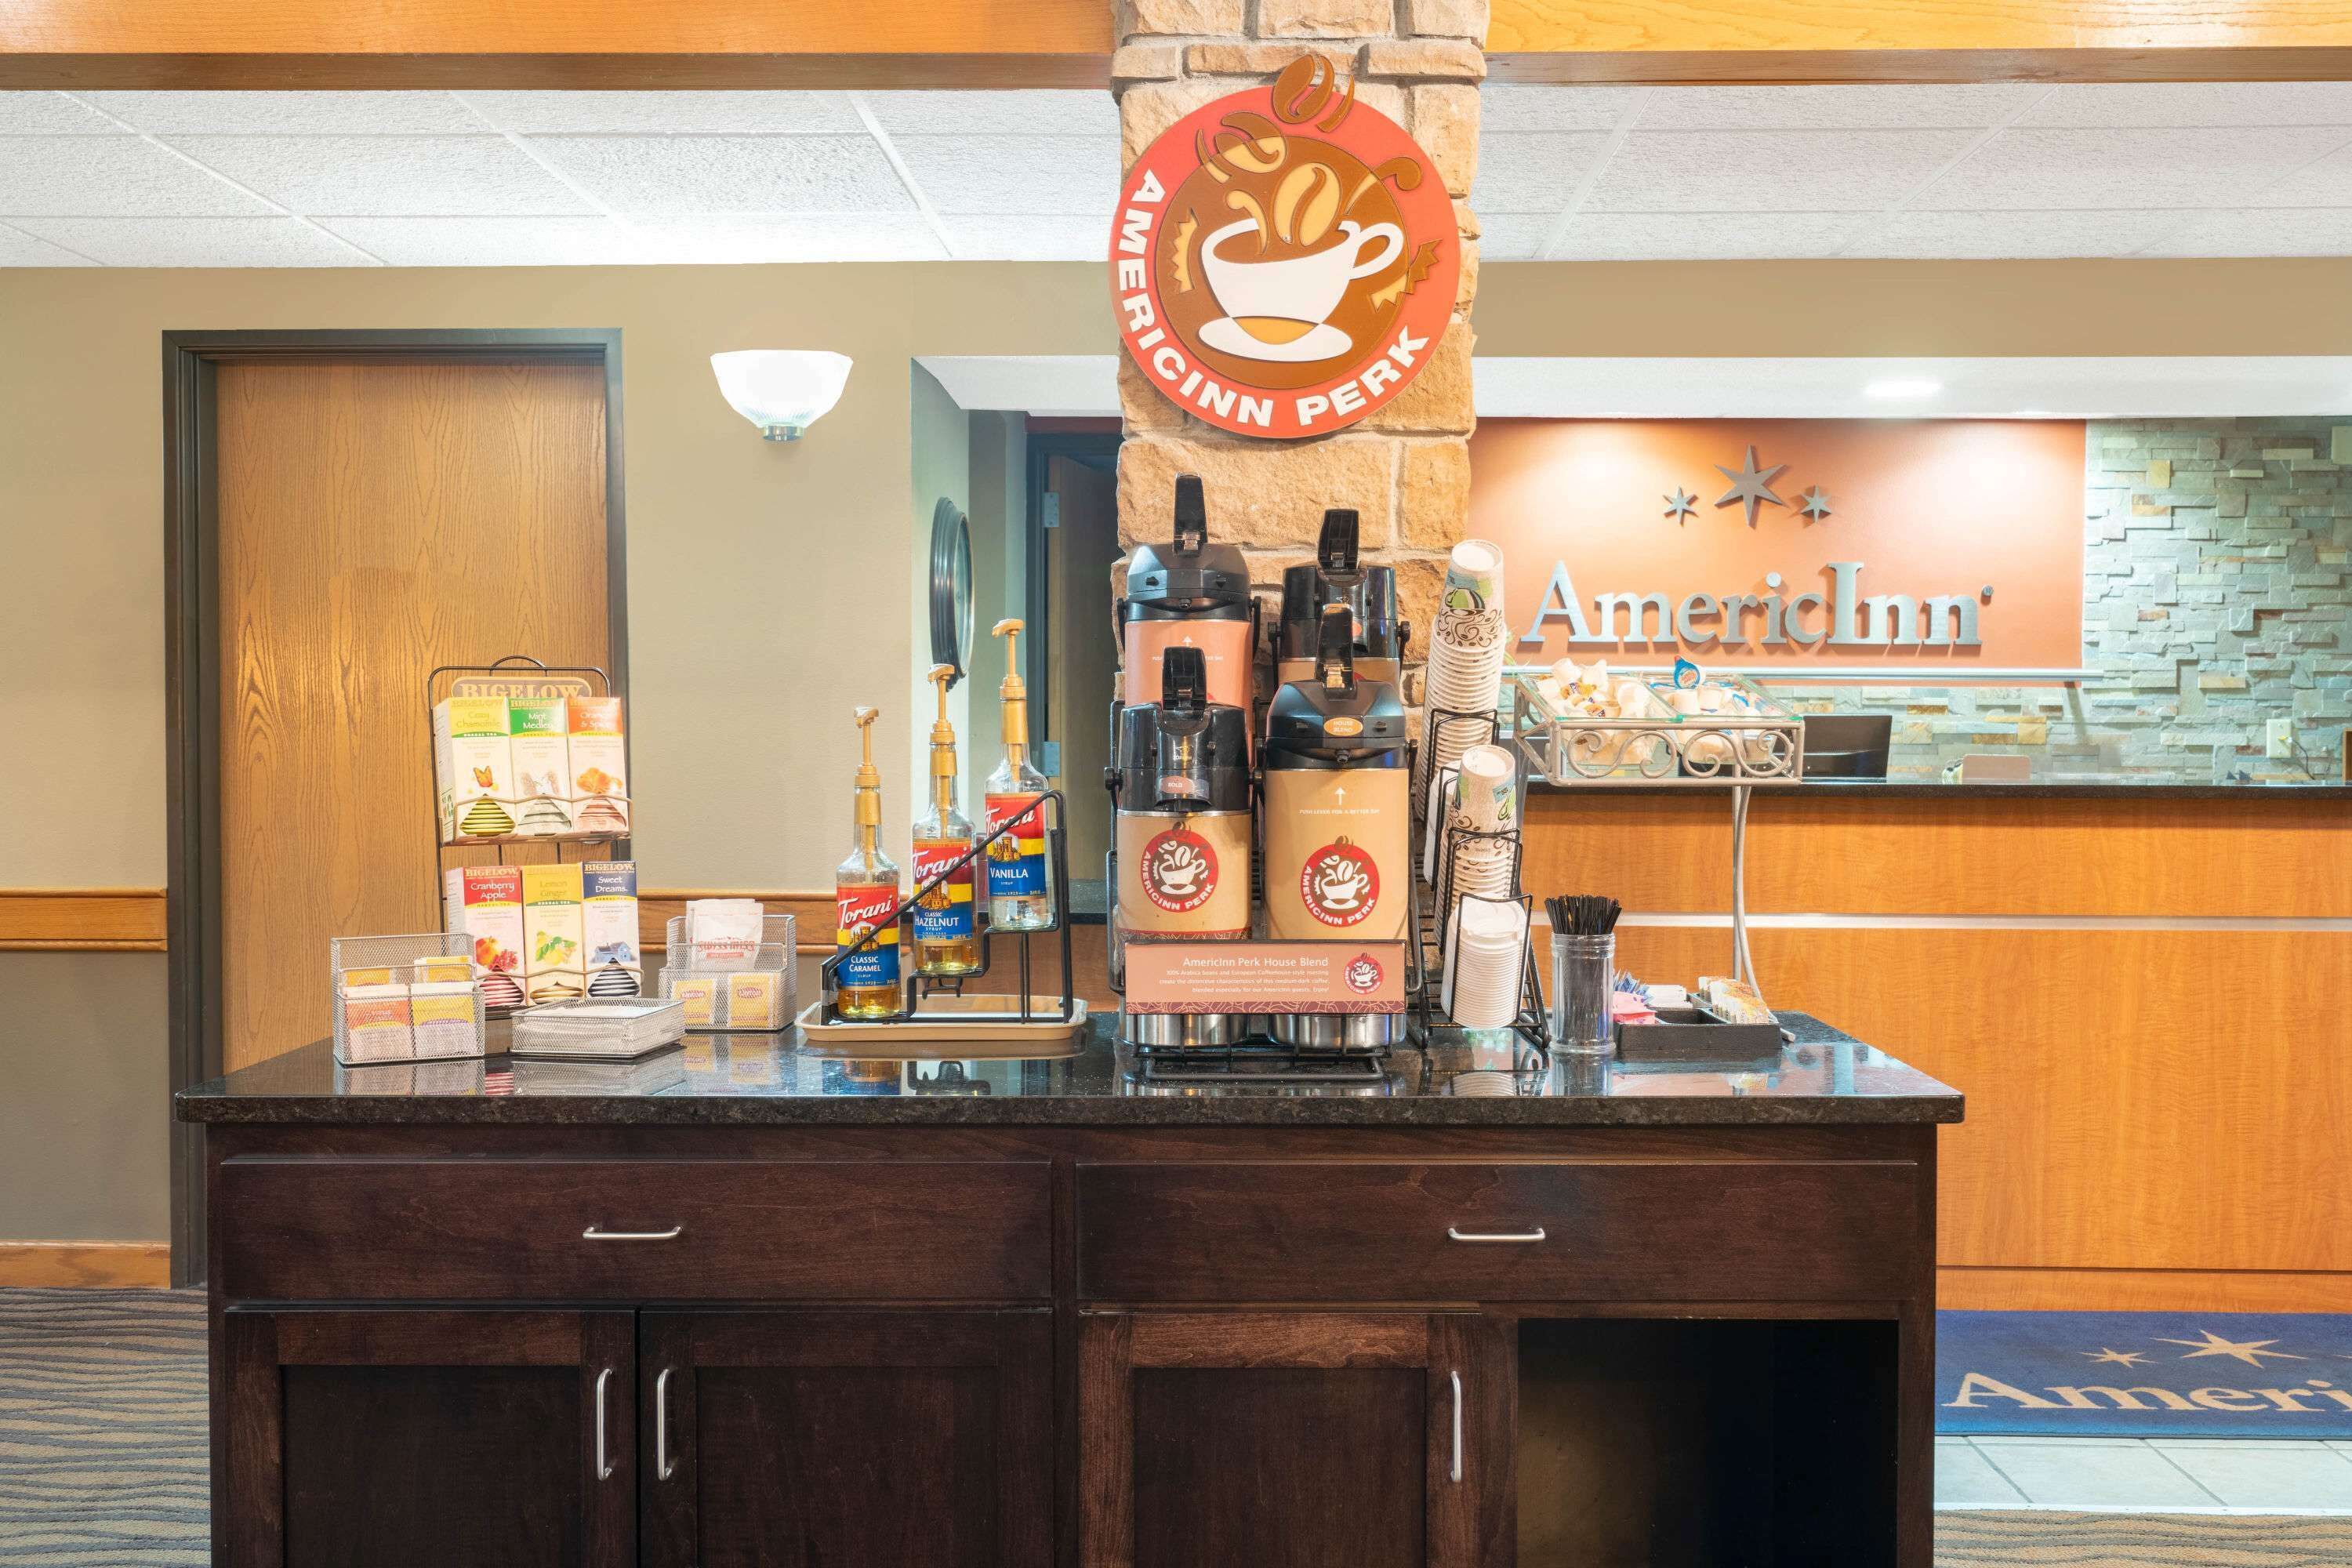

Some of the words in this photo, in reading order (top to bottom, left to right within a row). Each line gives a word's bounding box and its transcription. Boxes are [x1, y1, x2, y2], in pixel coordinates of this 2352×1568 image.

[1118, 168, 1273, 427] AMERICINN
[1294, 324, 1430, 426] PERK
[1520, 561, 1982, 645] AmericInn
[459, 684, 584, 697] BIGELOW
[528, 713, 546, 721] Mint
[990, 867, 1029, 878] VANILLA
[470, 877, 515, 892] Cranberry
[1142, 851, 1181, 910] AMERICINN
[1185, 883, 1214, 909] PERK
[480, 888, 507, 903] Apple
[1302, 865, 1343, 925] AMERICINN
[1347, 897, 1375, 924] PERK
[838, 895, 893, 931] Torani
[915, 916, 960, 927] HAZELNUT
[1183, 957, 1236, 967] AmericInn
[1238, 956, 1260, 967] Perk
[1264, 957, 1297, 967] House
[1300, 956, 1329, 967] Blend
